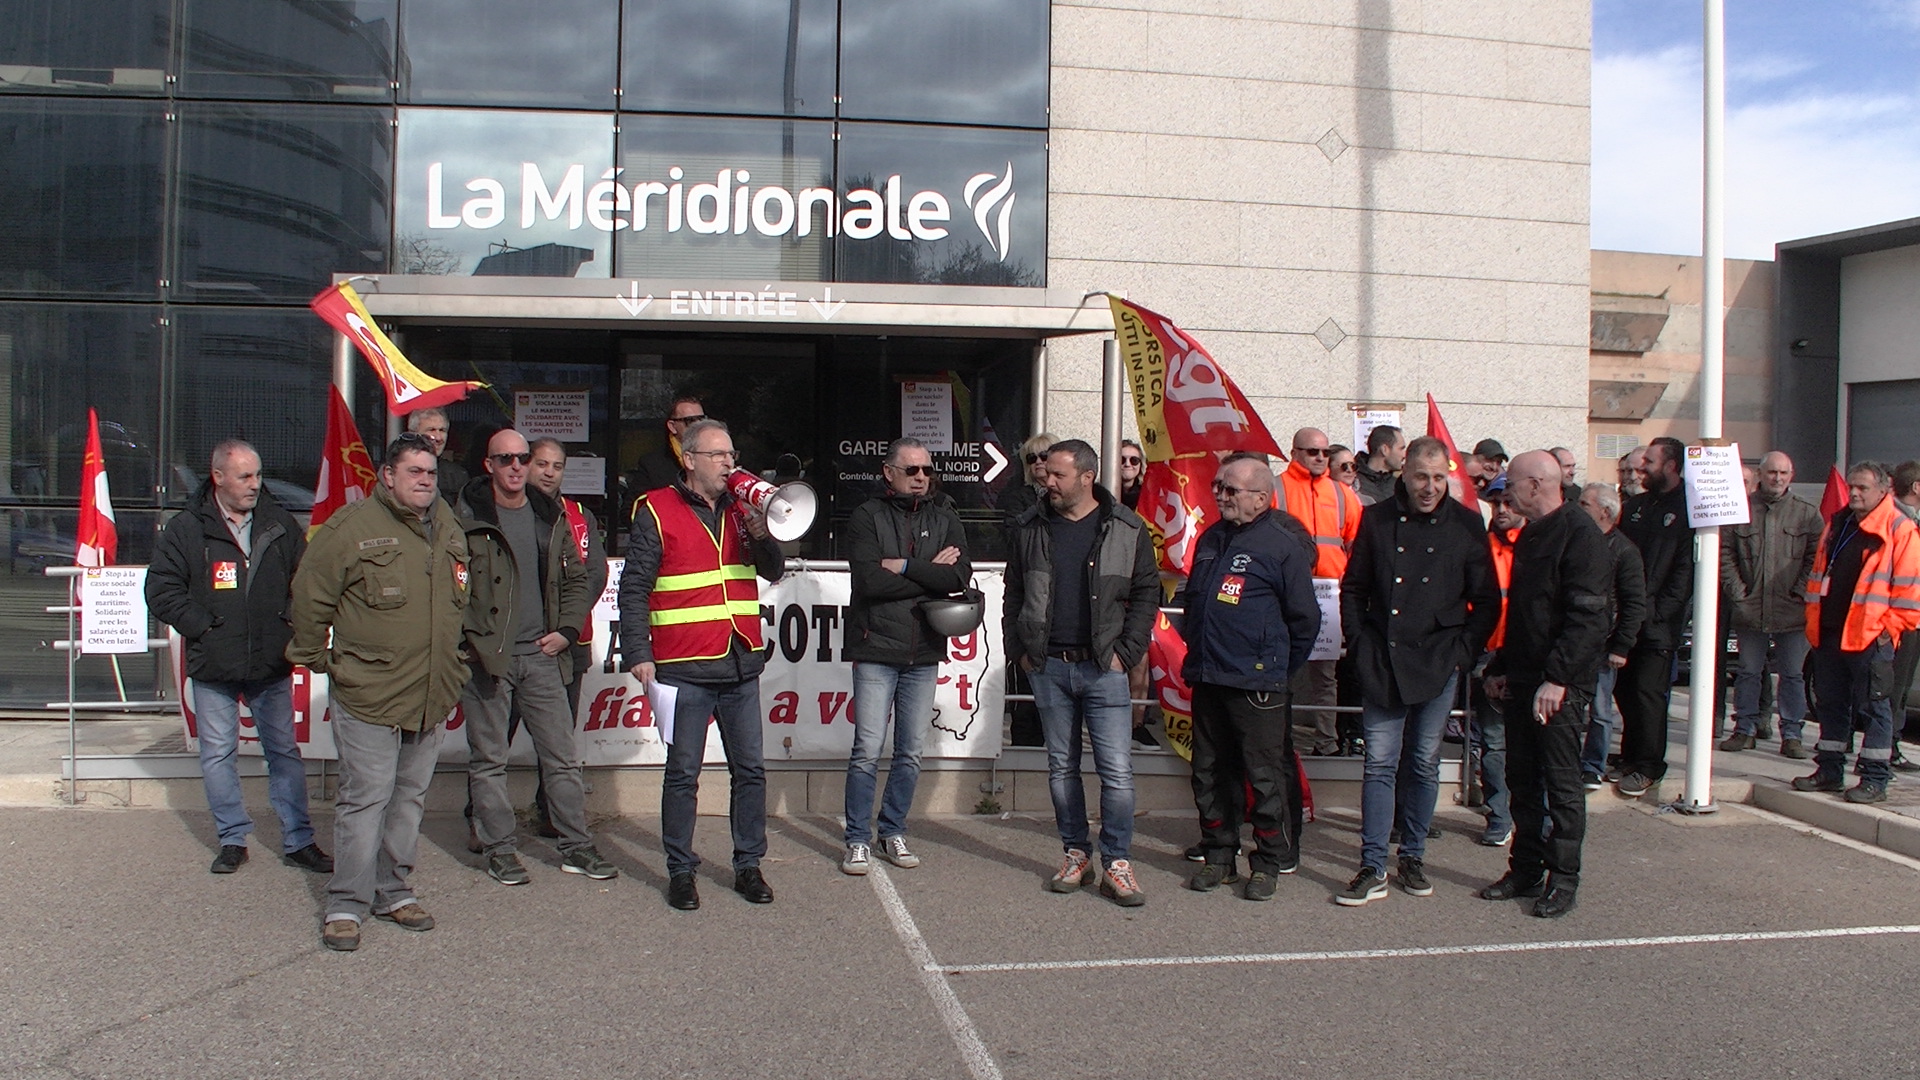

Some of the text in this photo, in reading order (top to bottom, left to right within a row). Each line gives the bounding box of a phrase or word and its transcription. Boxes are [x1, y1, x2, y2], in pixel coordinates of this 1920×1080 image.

[427, 162, 951, 241] La Méridionale
[670, 285, 797, 316] ENTRÉE
[839, 440, 889, 456] GARE
[945, 461, 980, 472] NORD
[839, 472, 874, 481] Contrôle
[942, 473, 979, 482] Billetterie
[1693, 502, 1720, 510] salariés
[216, 567, 237, 582] cgt
[1221, 582, 1242, 595] cgt
[95, 608, 131, 616] Solidarité
[583, 686, 657, 732] fia
